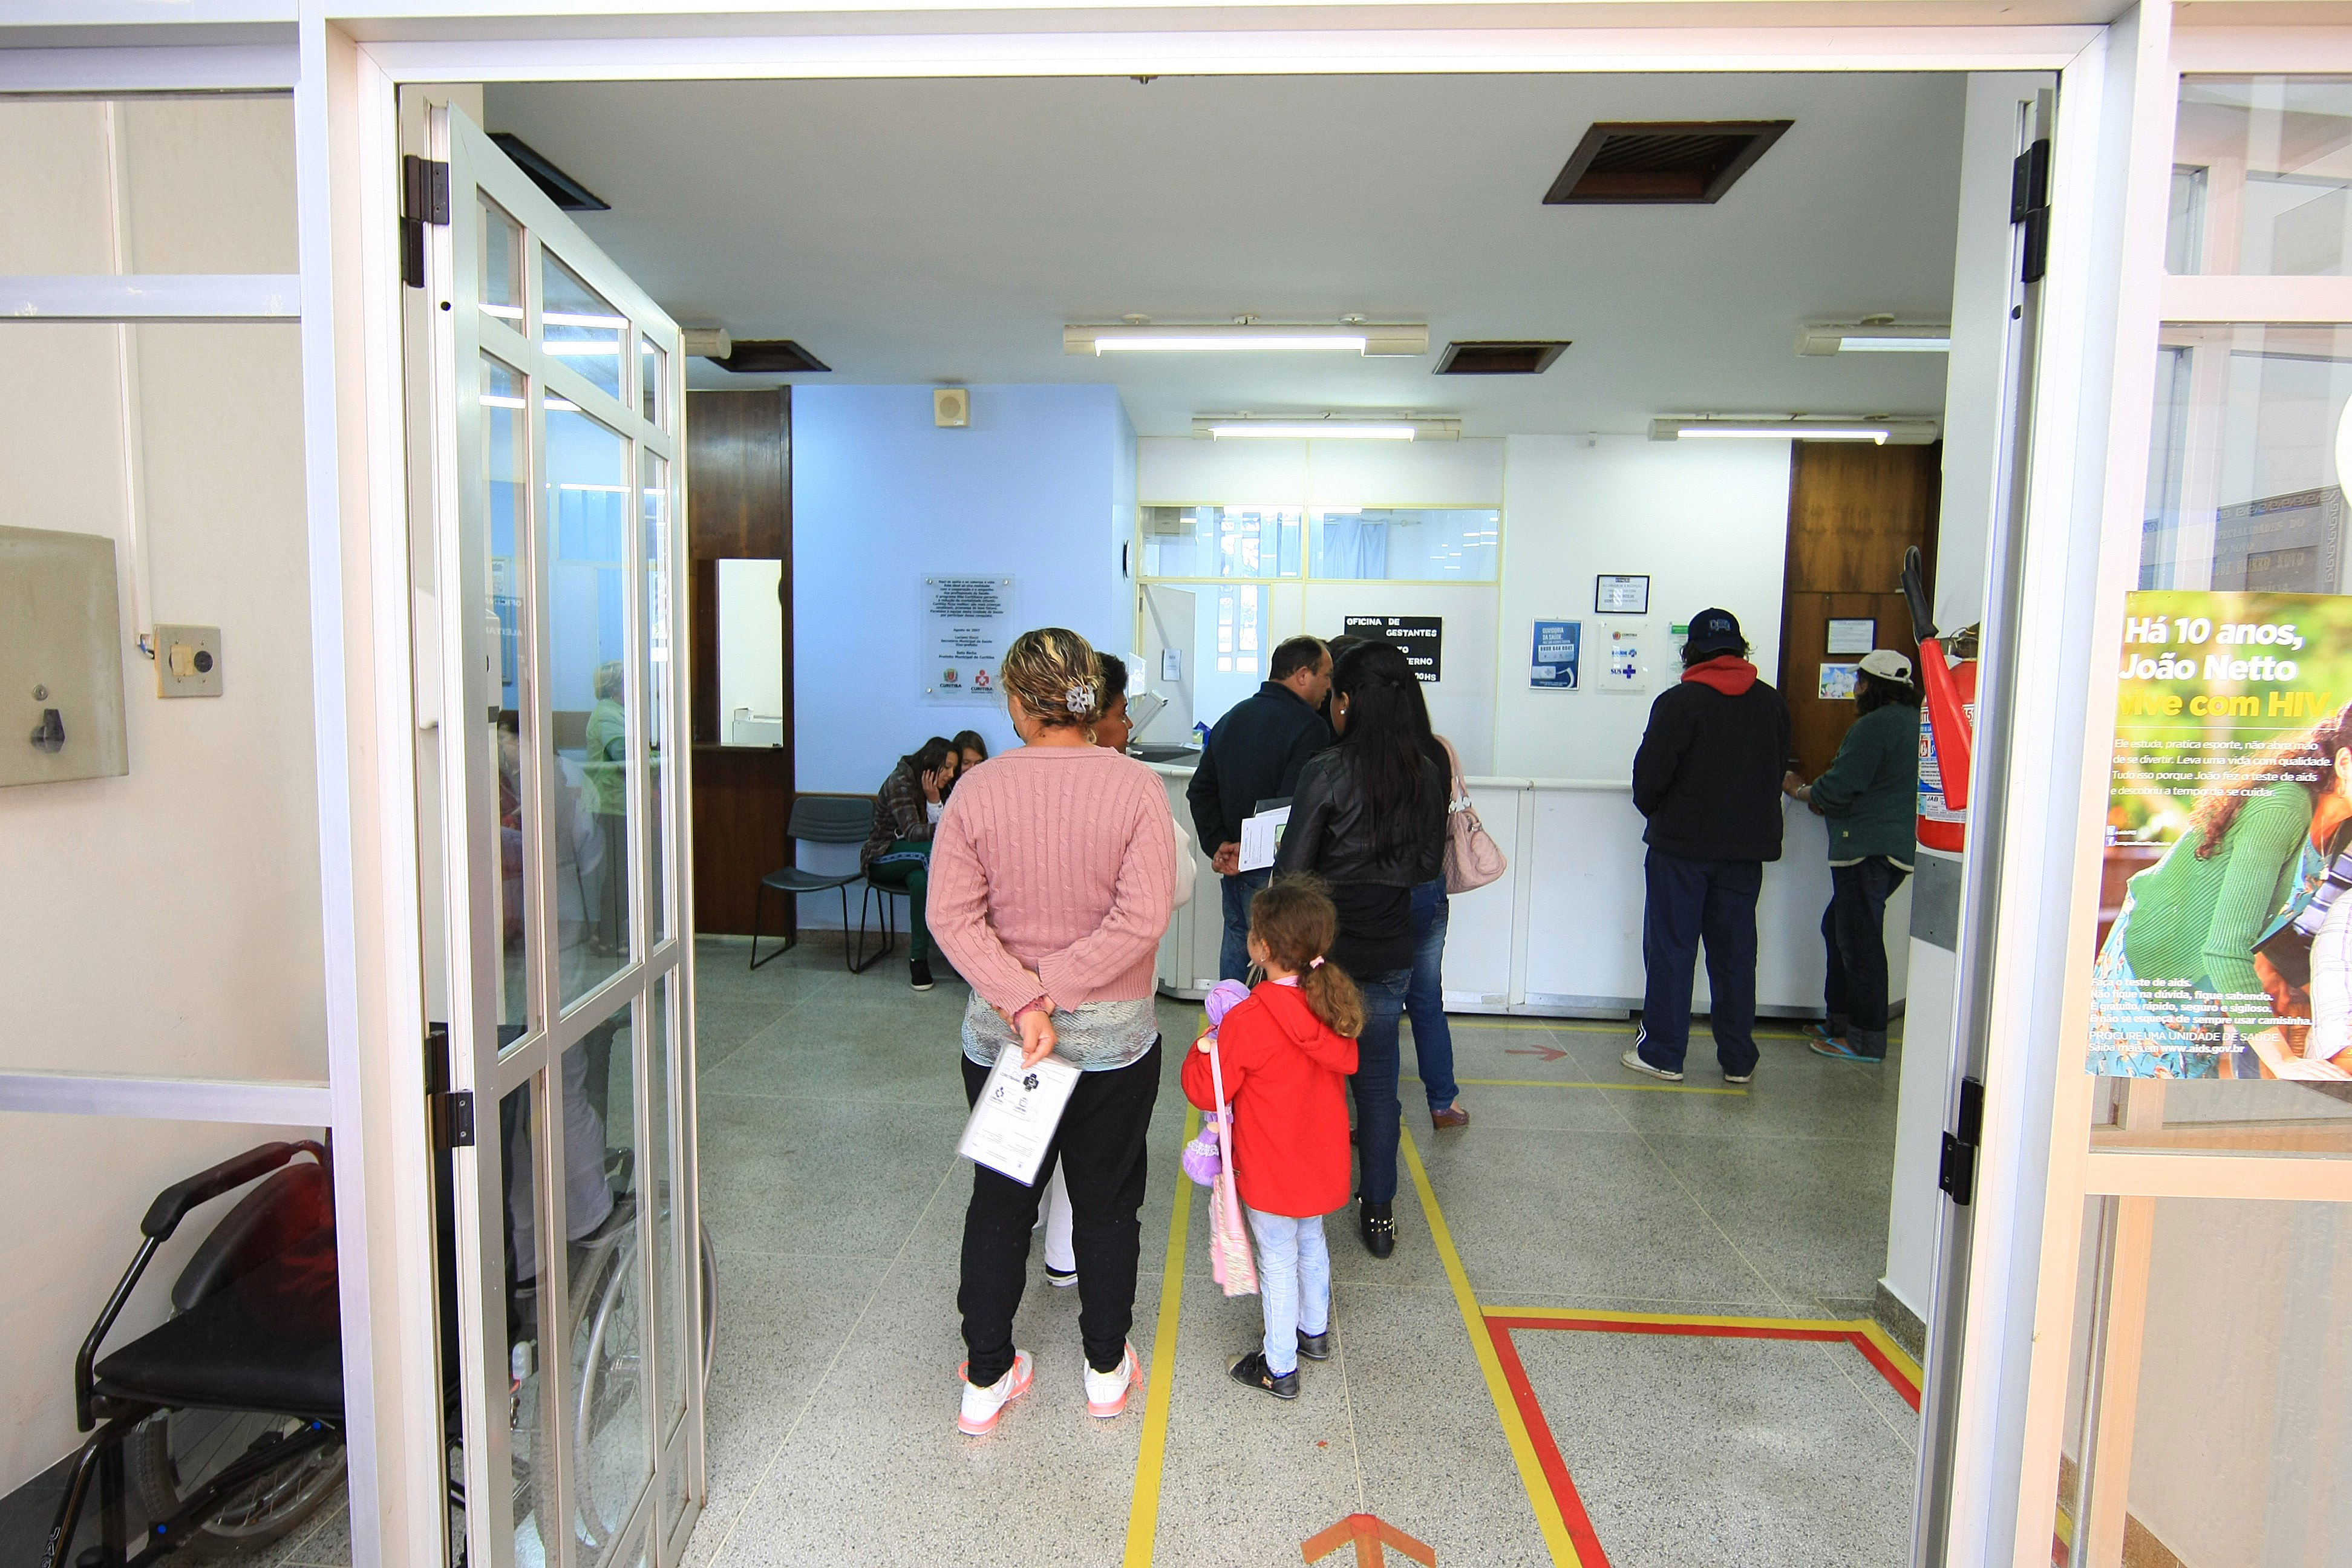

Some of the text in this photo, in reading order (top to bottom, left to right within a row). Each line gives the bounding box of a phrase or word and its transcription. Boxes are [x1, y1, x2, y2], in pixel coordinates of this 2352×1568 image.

[2125, 616, 2304, 651] Há 10 anos,
[2118, 652, 2297, 682] João Netto
[2119, 689, 2337, 717] vive com HIV.
[2114, 739, 2319, 750] Ele estuda, pratica esporte, não abre mão
[2112, 755, 2125, 764] de
[2140, 755, 2174, 764] divertir.
[2177, 756, 2201, 765] Leva
[2227, 757, 2251, 765] vida
[2278, 757, 2333, 767] qualidade.
[2112, 770, 2135, 779] Tudo
[2137, 771, 2154, 779] isso
[2155, 772, 2194, 781] porque
[2195, 771, 2220, 780] João
[2223, 771, 2239, 780] fez
[2252, 773, 2278, 781] teste
[2280, 772, 2295, 781] de
[2296, 773, 2318, 782] aids
[2118, 786, 2162, 795] descobriu
[2173, 787, 2207, 796] tempo
[2210, 787, 2224, 796] de
[2240, 788, 2276, 797] cuidar.
[2091, 978, 2114, 987] Faça
[2152, 978, 2166, 987] de
[2167, 978, 2192, 987] aids.
[2091, 989, 2111, 999] Não
[2112, 990, 2138, 1000] fique
[2154, 989, 2193, 1000] dúvida,
[2195, 990, 2223, 1001] fique
[2225, 992, 2274, 1001] sabendo.
[2100, 1002, 2140, 1012] gratuito,
[2142, 1002, 2178, 1012] rápido,
[2180, 1004, 2219, 1013] seguro
[2230, 1004, 2273, 1014] sigiloso.
[2100, 1013, 2118, 1023] não
[2134, 1016, 2174, 1024] esqueça
[2175, 1014, 2190, 1024] de
[2192, 1016, 2232, 1026] sempre
[2258, 1016, 2313, 1026] camisinha.
[2089, 1031, 2144, 1040] PROCURE
[2145, 1031, 2167, 1040] UMA
[2168, 1031, 2221, 1041] UNIDADE
[2223, 1033, 2238, 1041] DE
[2088, 1042, 2115, 1051] Saiba
[2117, 1044, 2142, 1052] mais
[2160, 1044, 2246, 1054] www.aids.gov.br
